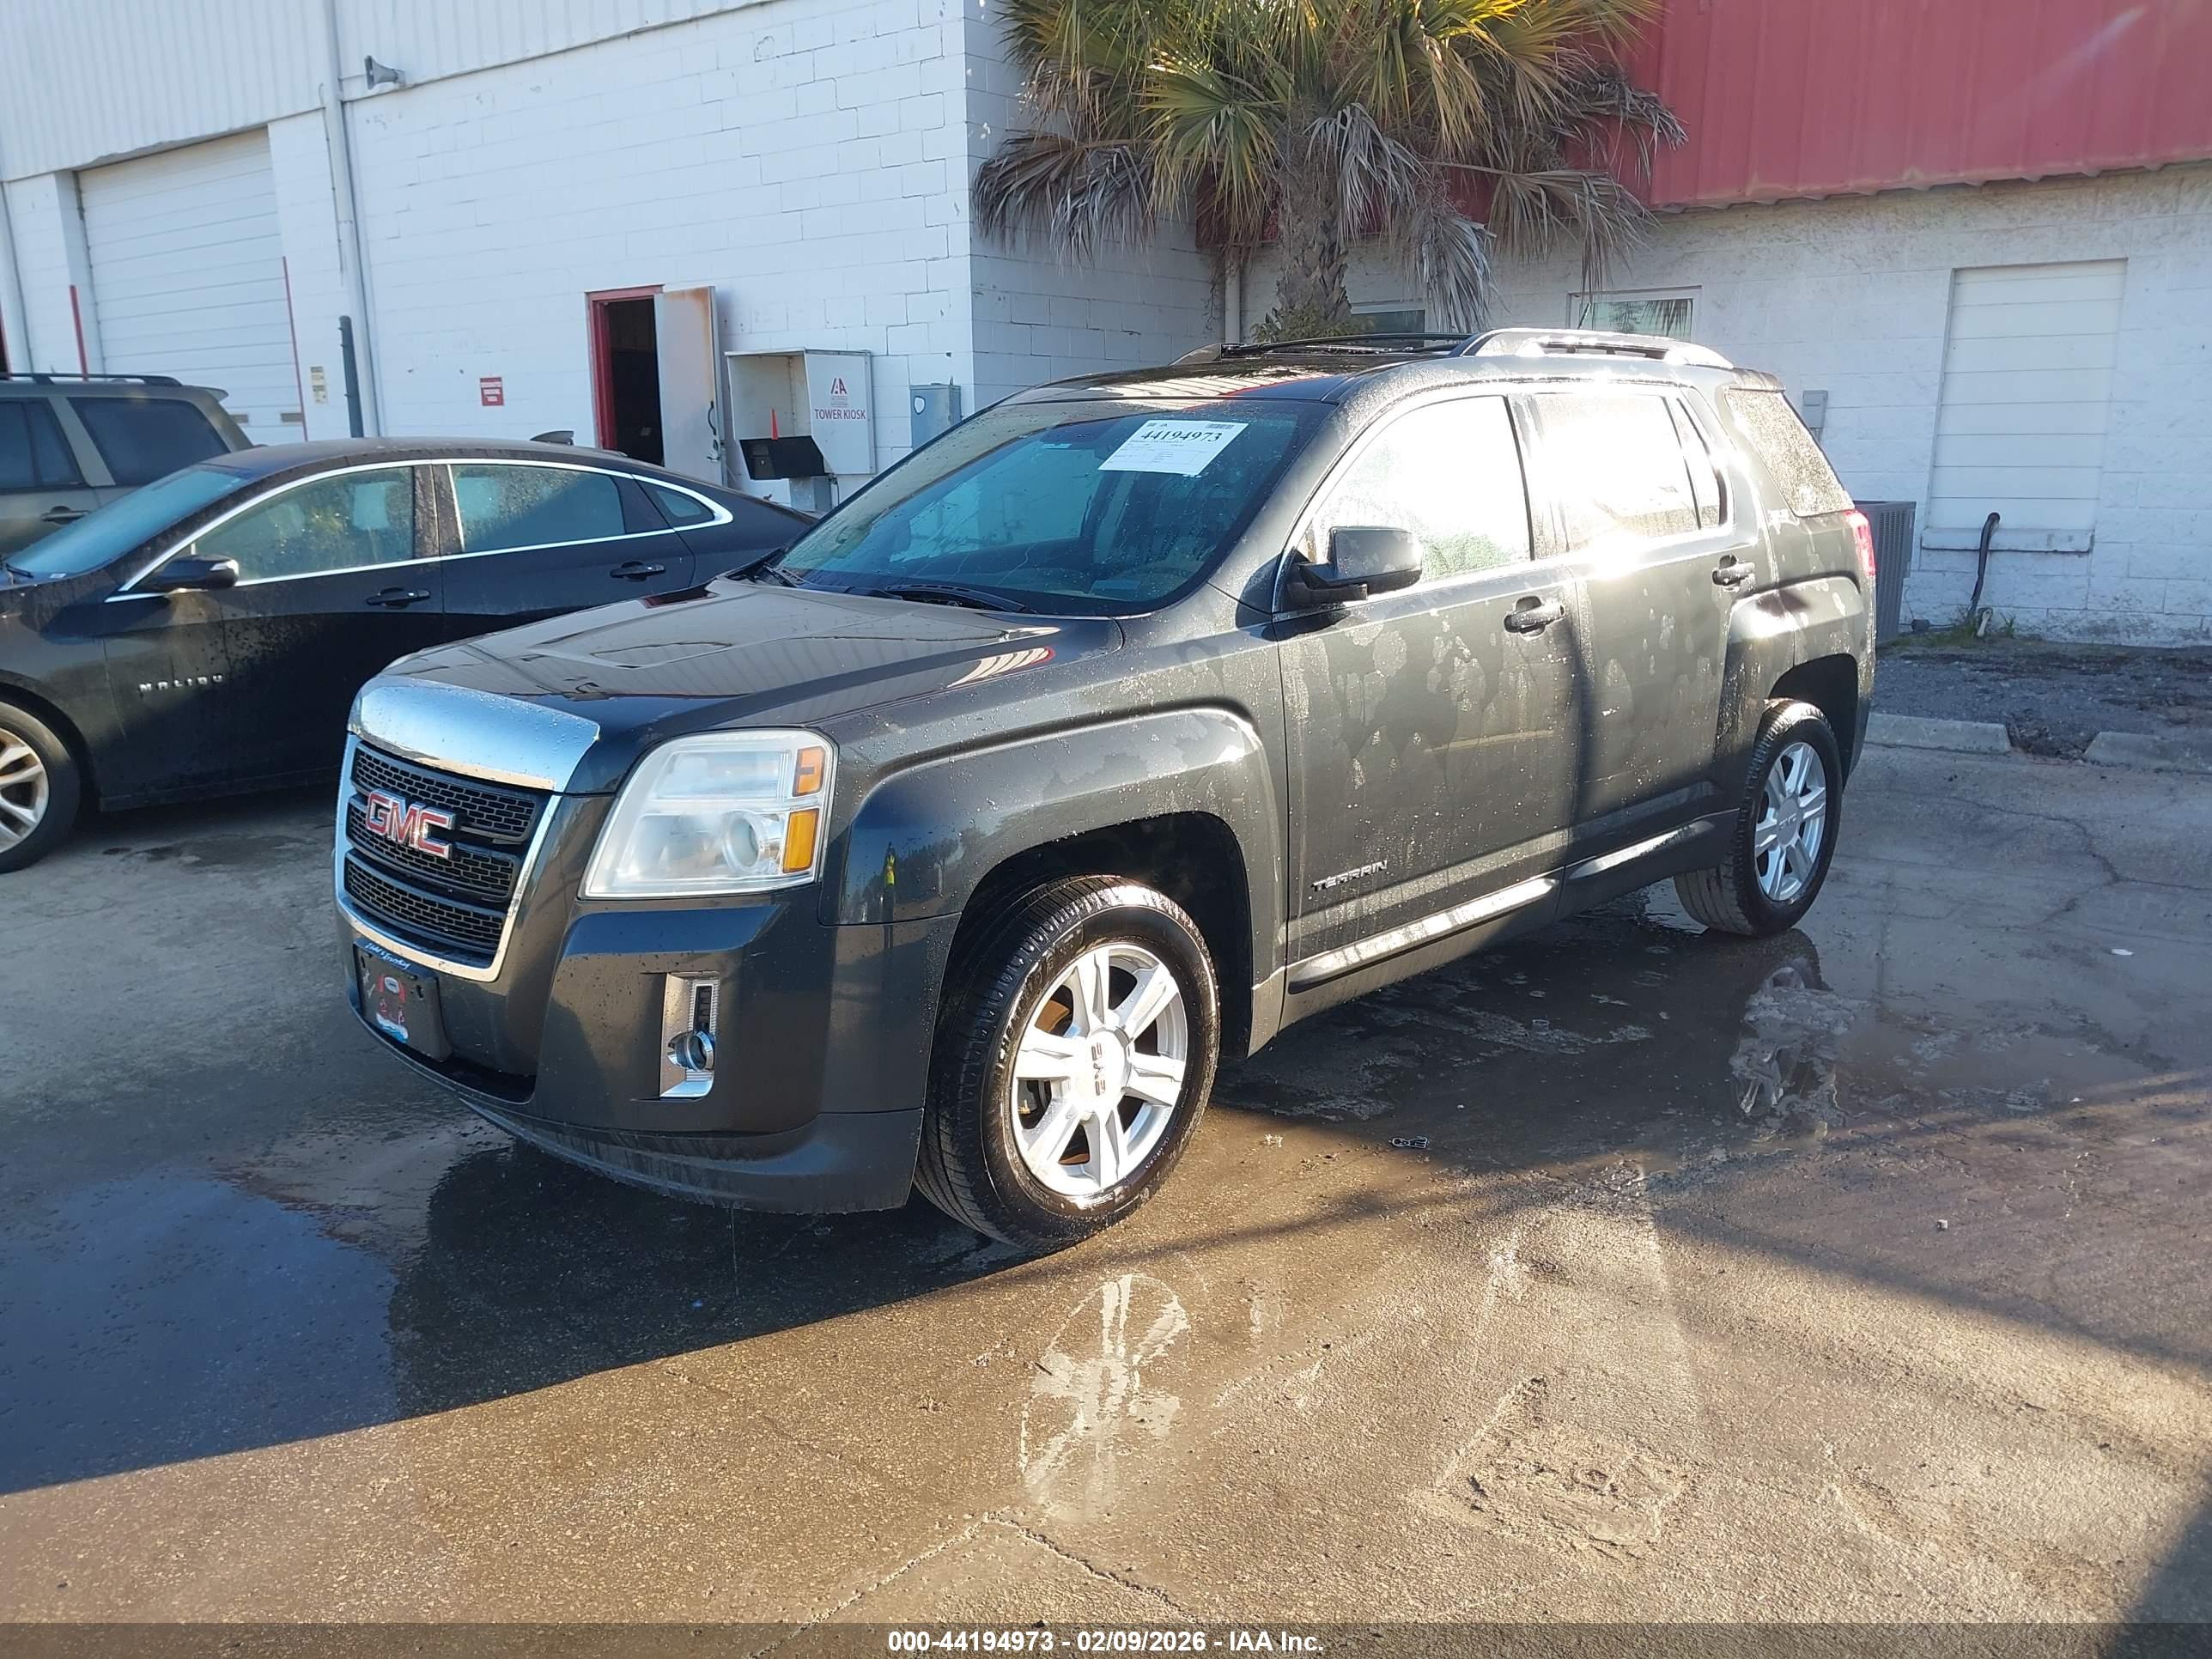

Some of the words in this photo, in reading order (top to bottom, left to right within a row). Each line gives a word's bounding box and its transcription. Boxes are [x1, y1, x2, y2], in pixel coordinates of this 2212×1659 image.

[814, 409, 842, 419] TOWER
[844, 409, 866, 419] KIOSK
[1141, 430, 1222, 441] 44194973
[139, 674, 222, 691] MALIBU
[366, 788, 456, 859] GMC
[1311, 860, 1388, 891] TERRAIN
